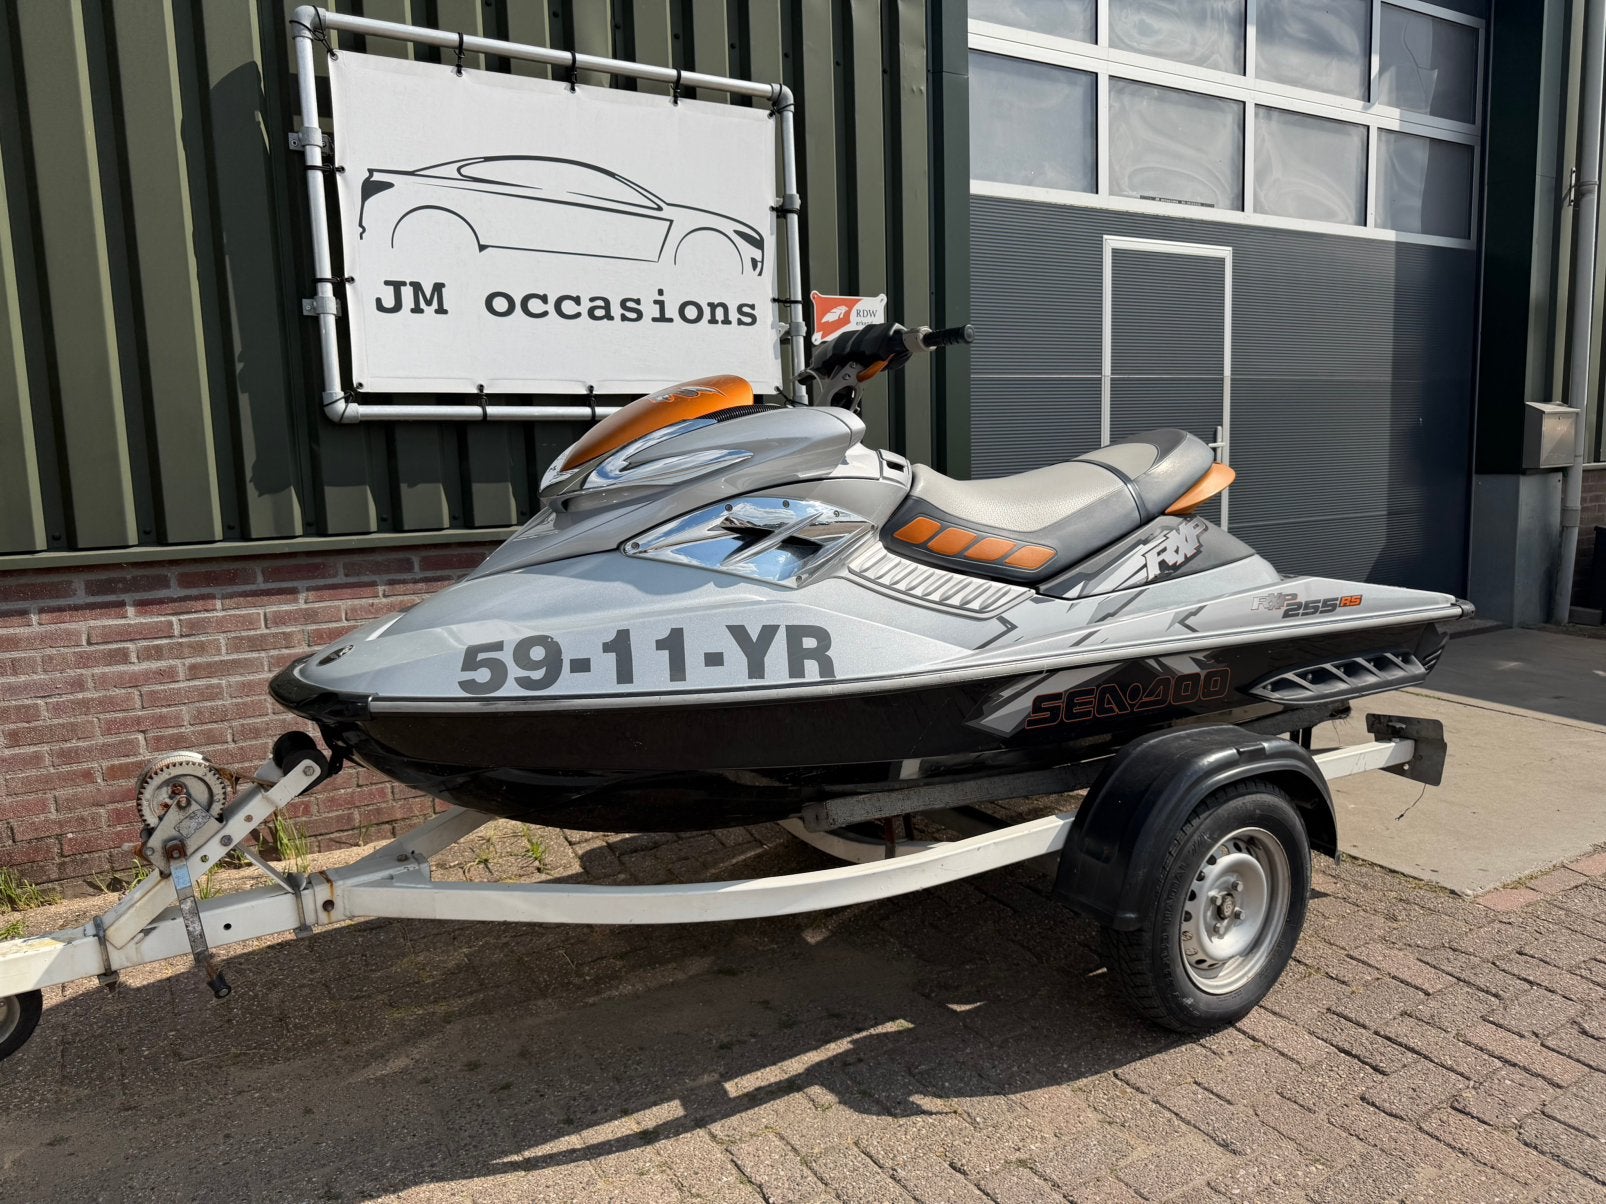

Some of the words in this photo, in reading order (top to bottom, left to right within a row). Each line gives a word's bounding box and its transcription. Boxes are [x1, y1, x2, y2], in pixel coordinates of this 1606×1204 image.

[375, 280, 449, 315] JM
[484, 288, 758, 326] occasions
[856, 309, 878, 318] RDW
[1281, 597, 1339, 619] 255
[1340, 594, 1363, 608] RS
[457, 624, 837, 695] 59-11-YR
